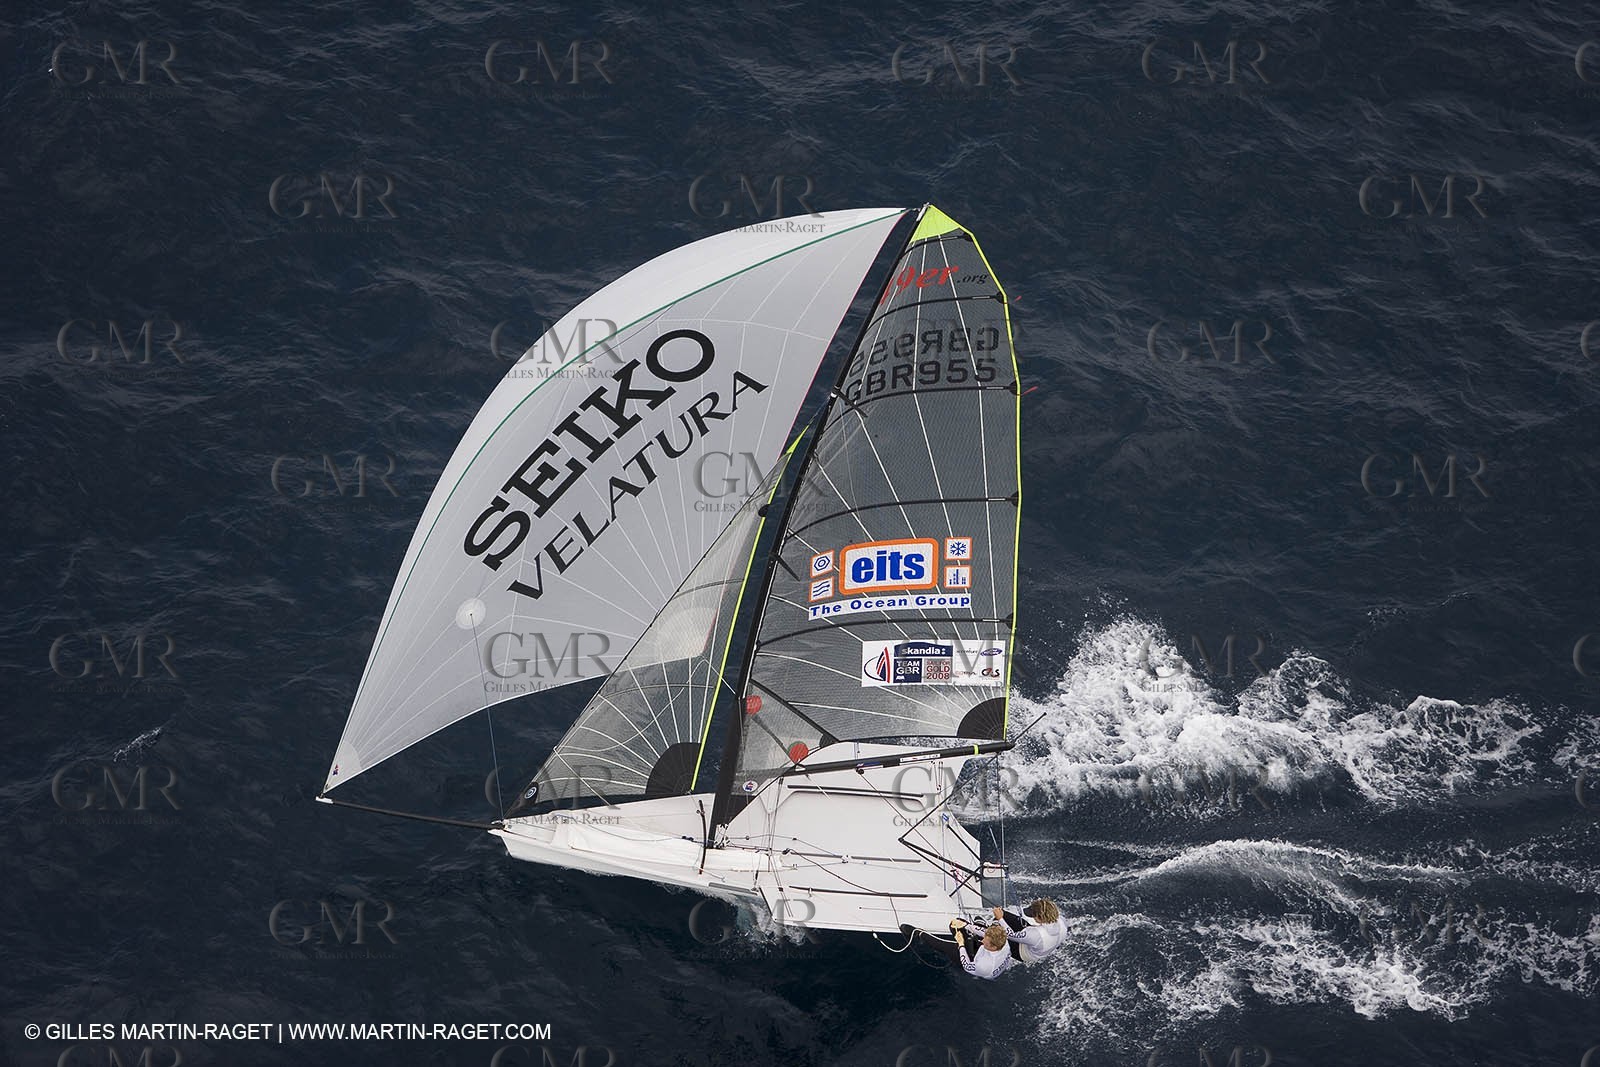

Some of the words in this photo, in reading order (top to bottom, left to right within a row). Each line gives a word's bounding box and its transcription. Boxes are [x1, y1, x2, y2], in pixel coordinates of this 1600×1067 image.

[846, 358, 997, 405] GBR955
[463, 328, 716, 572] SEIKO
[506, 370, 769, 600] VELATURA
[851, 550, 925, 583] eits
[811, 604, 842, 617] The
[850, 597, 908, 610] Ocean
[915, 596, 970, 607] Group
[896, 666, 920, 675] GBR
[926, 665, 950, 673] GOLD
[926, 672, 950, 680] 2008
